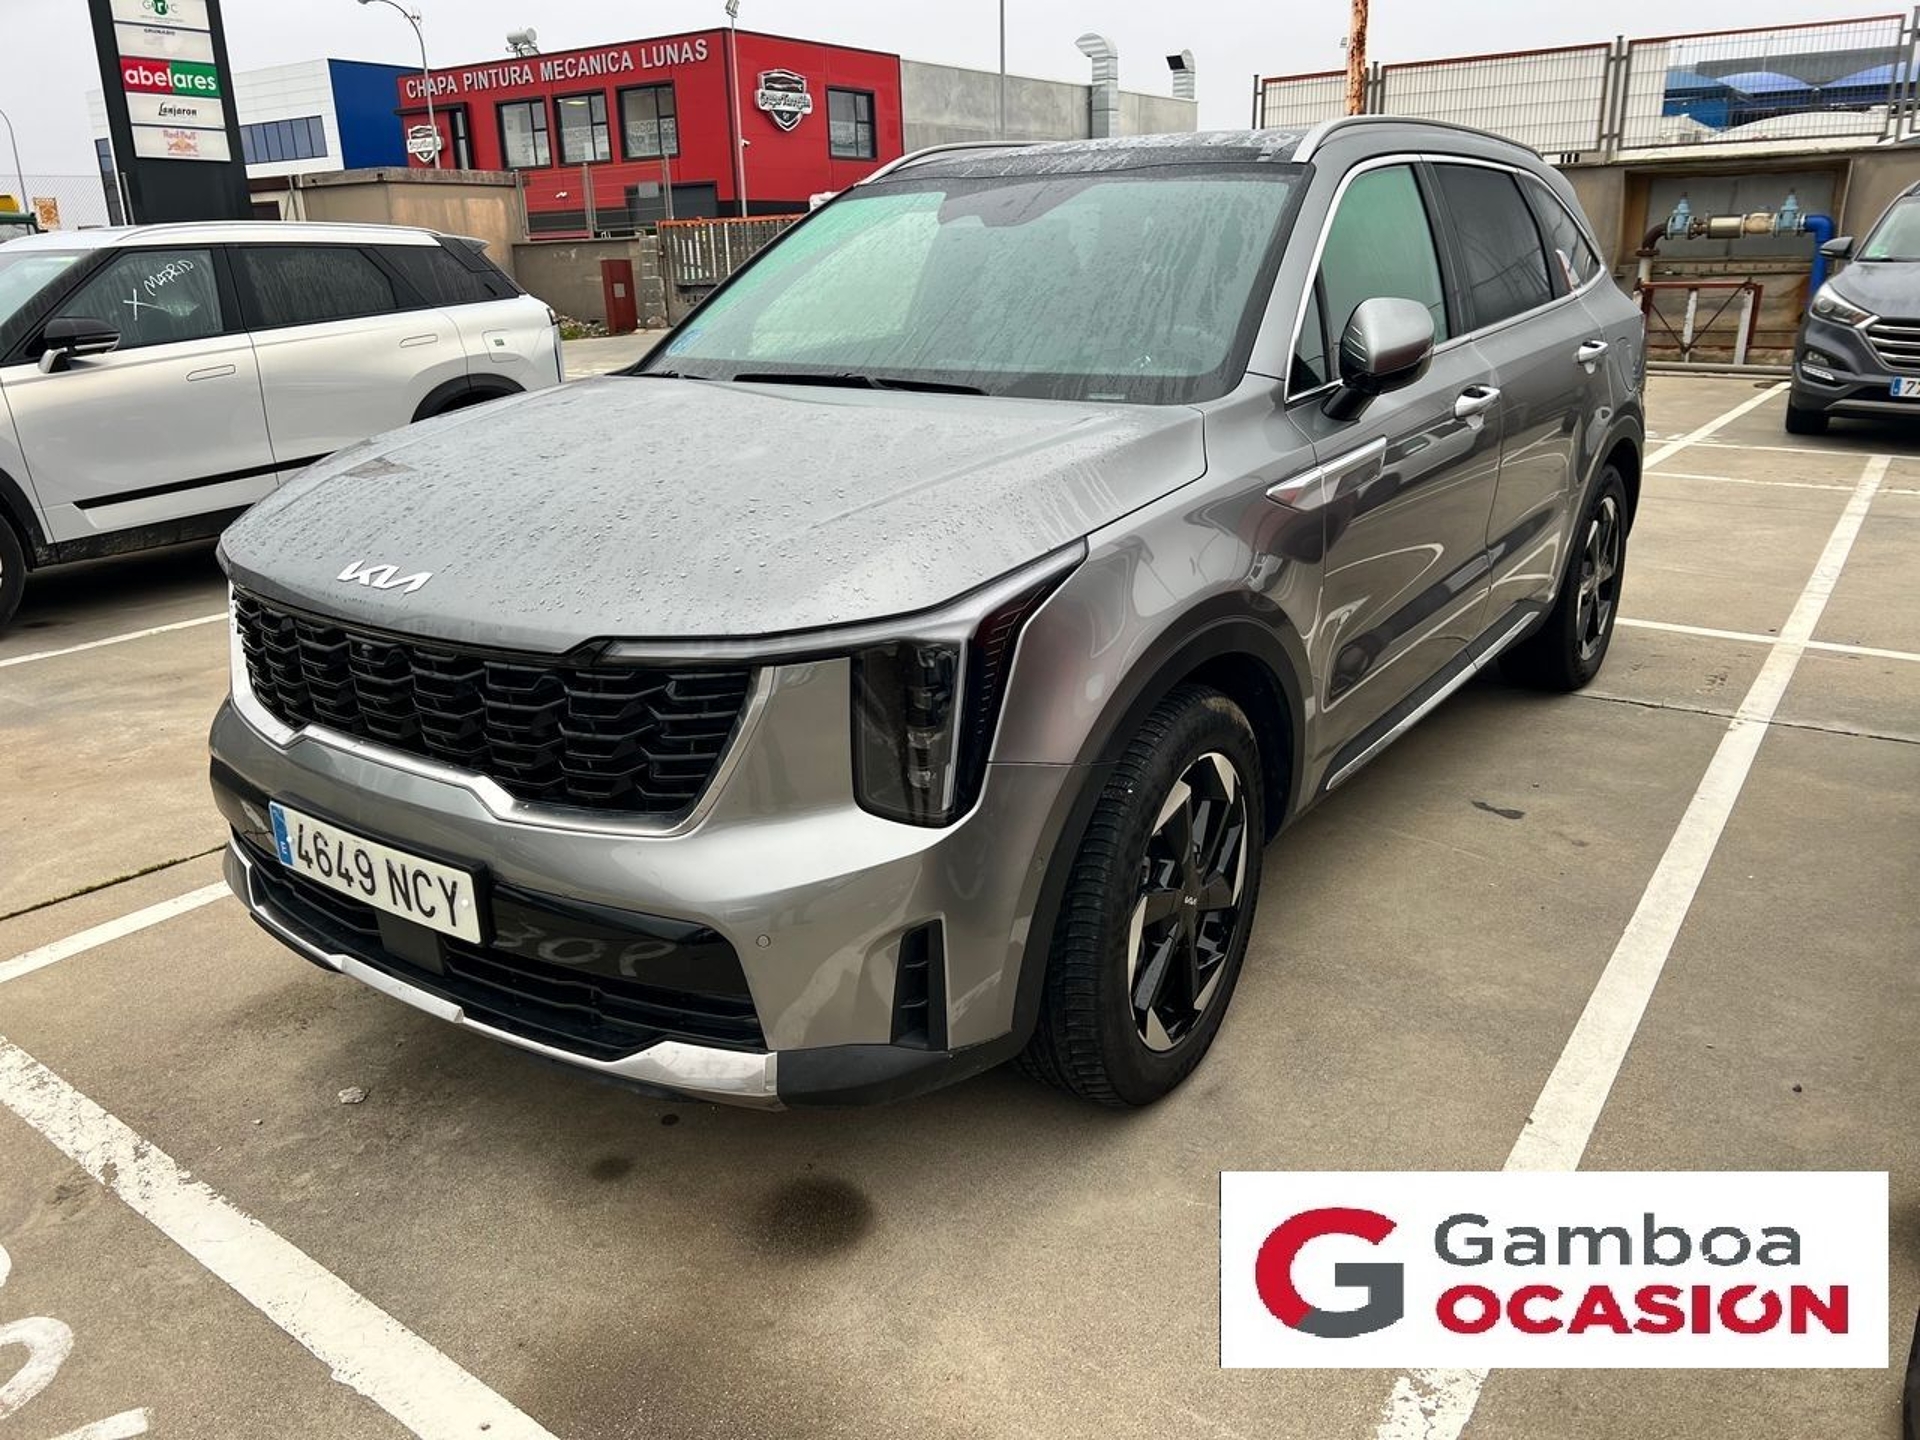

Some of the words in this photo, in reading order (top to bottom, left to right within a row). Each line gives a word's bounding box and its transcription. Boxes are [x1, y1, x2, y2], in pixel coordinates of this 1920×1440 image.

[124, 65, 217, 91] abelares
[405, 73, 457, 99] CHAPA
[463, 61, 535, 91] PINTURA
[540, 50, 634, 82] MECANICA
[641, 38, 708, 68] LUNAS
[143, 260, 194, 296] MADRID
[336, 560, 433, 594] KIA
[297, 823, 376, 896] 4649
[385, 858, 458, 927] NCY
